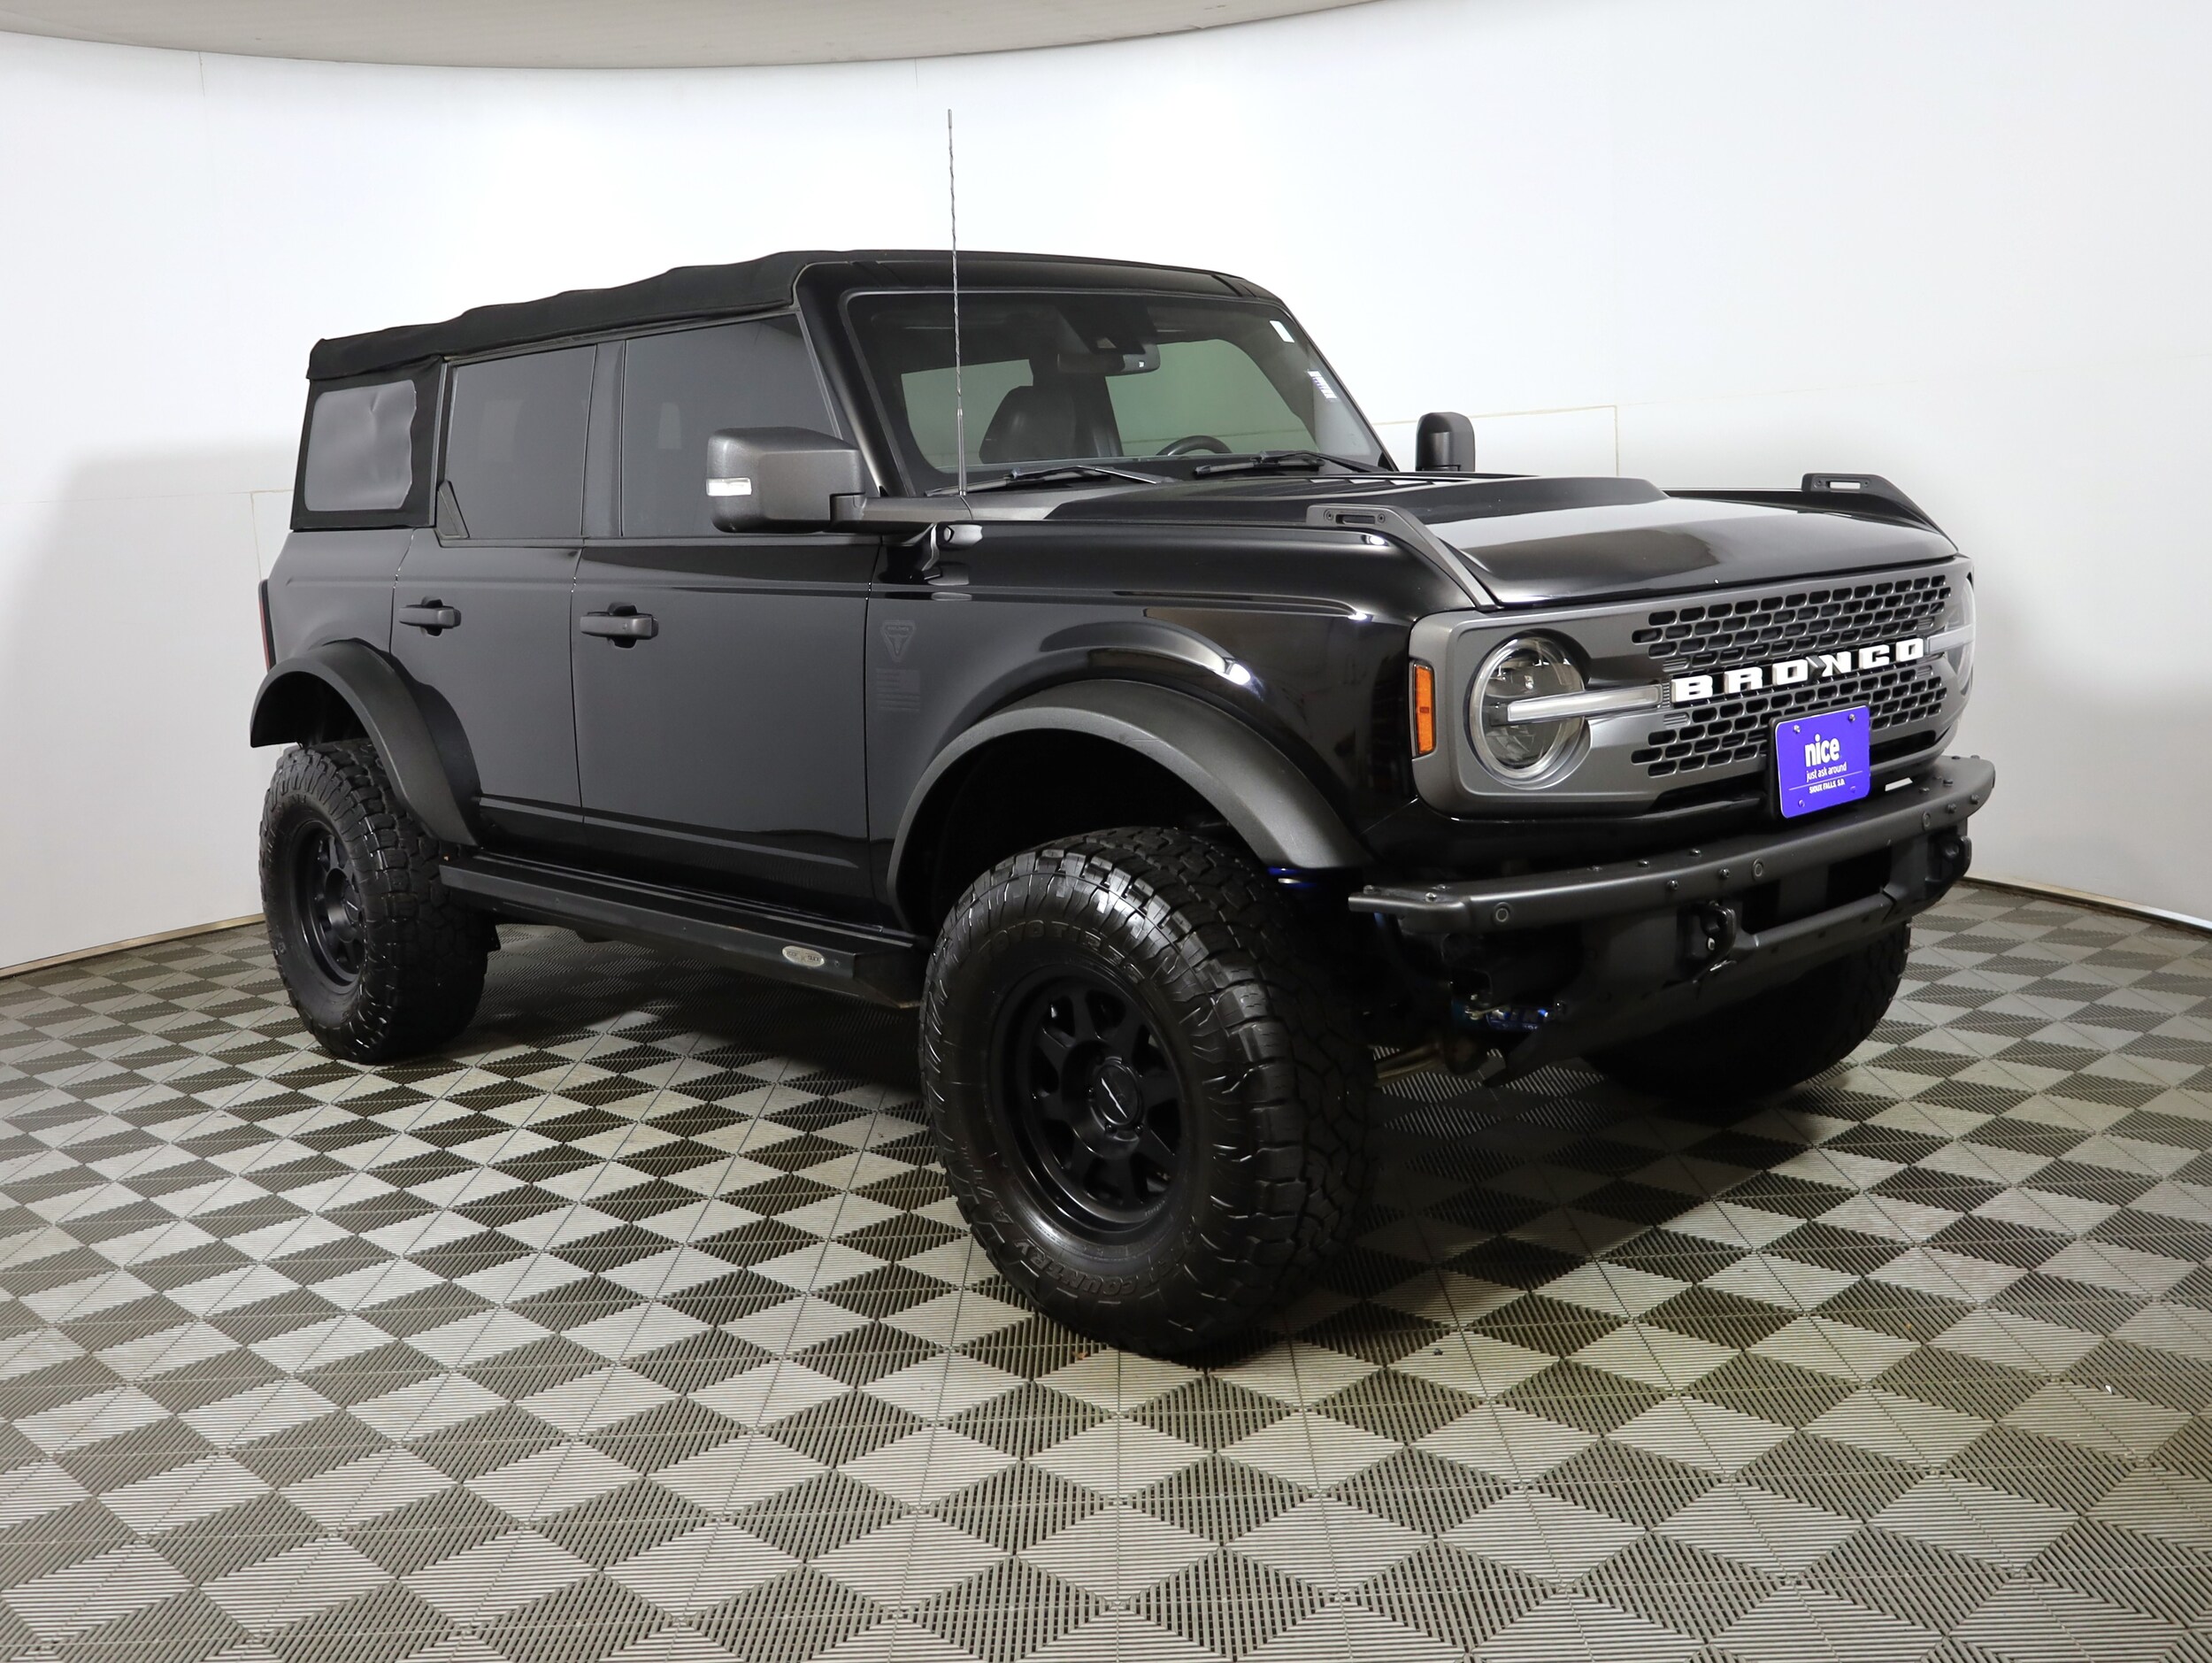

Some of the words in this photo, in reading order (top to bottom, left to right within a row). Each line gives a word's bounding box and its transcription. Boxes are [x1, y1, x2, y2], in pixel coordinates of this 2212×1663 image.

[1671, 637, 1924, 702] BRONCO
[1805, 734, 1839, 767] nice
[1807, 769, 1817, 783] just
[1817, 766, 1827, 777] ask
[1828, 761, 1847, 774] around
[1012, 1237, 1139, 1296] COUNTRY
